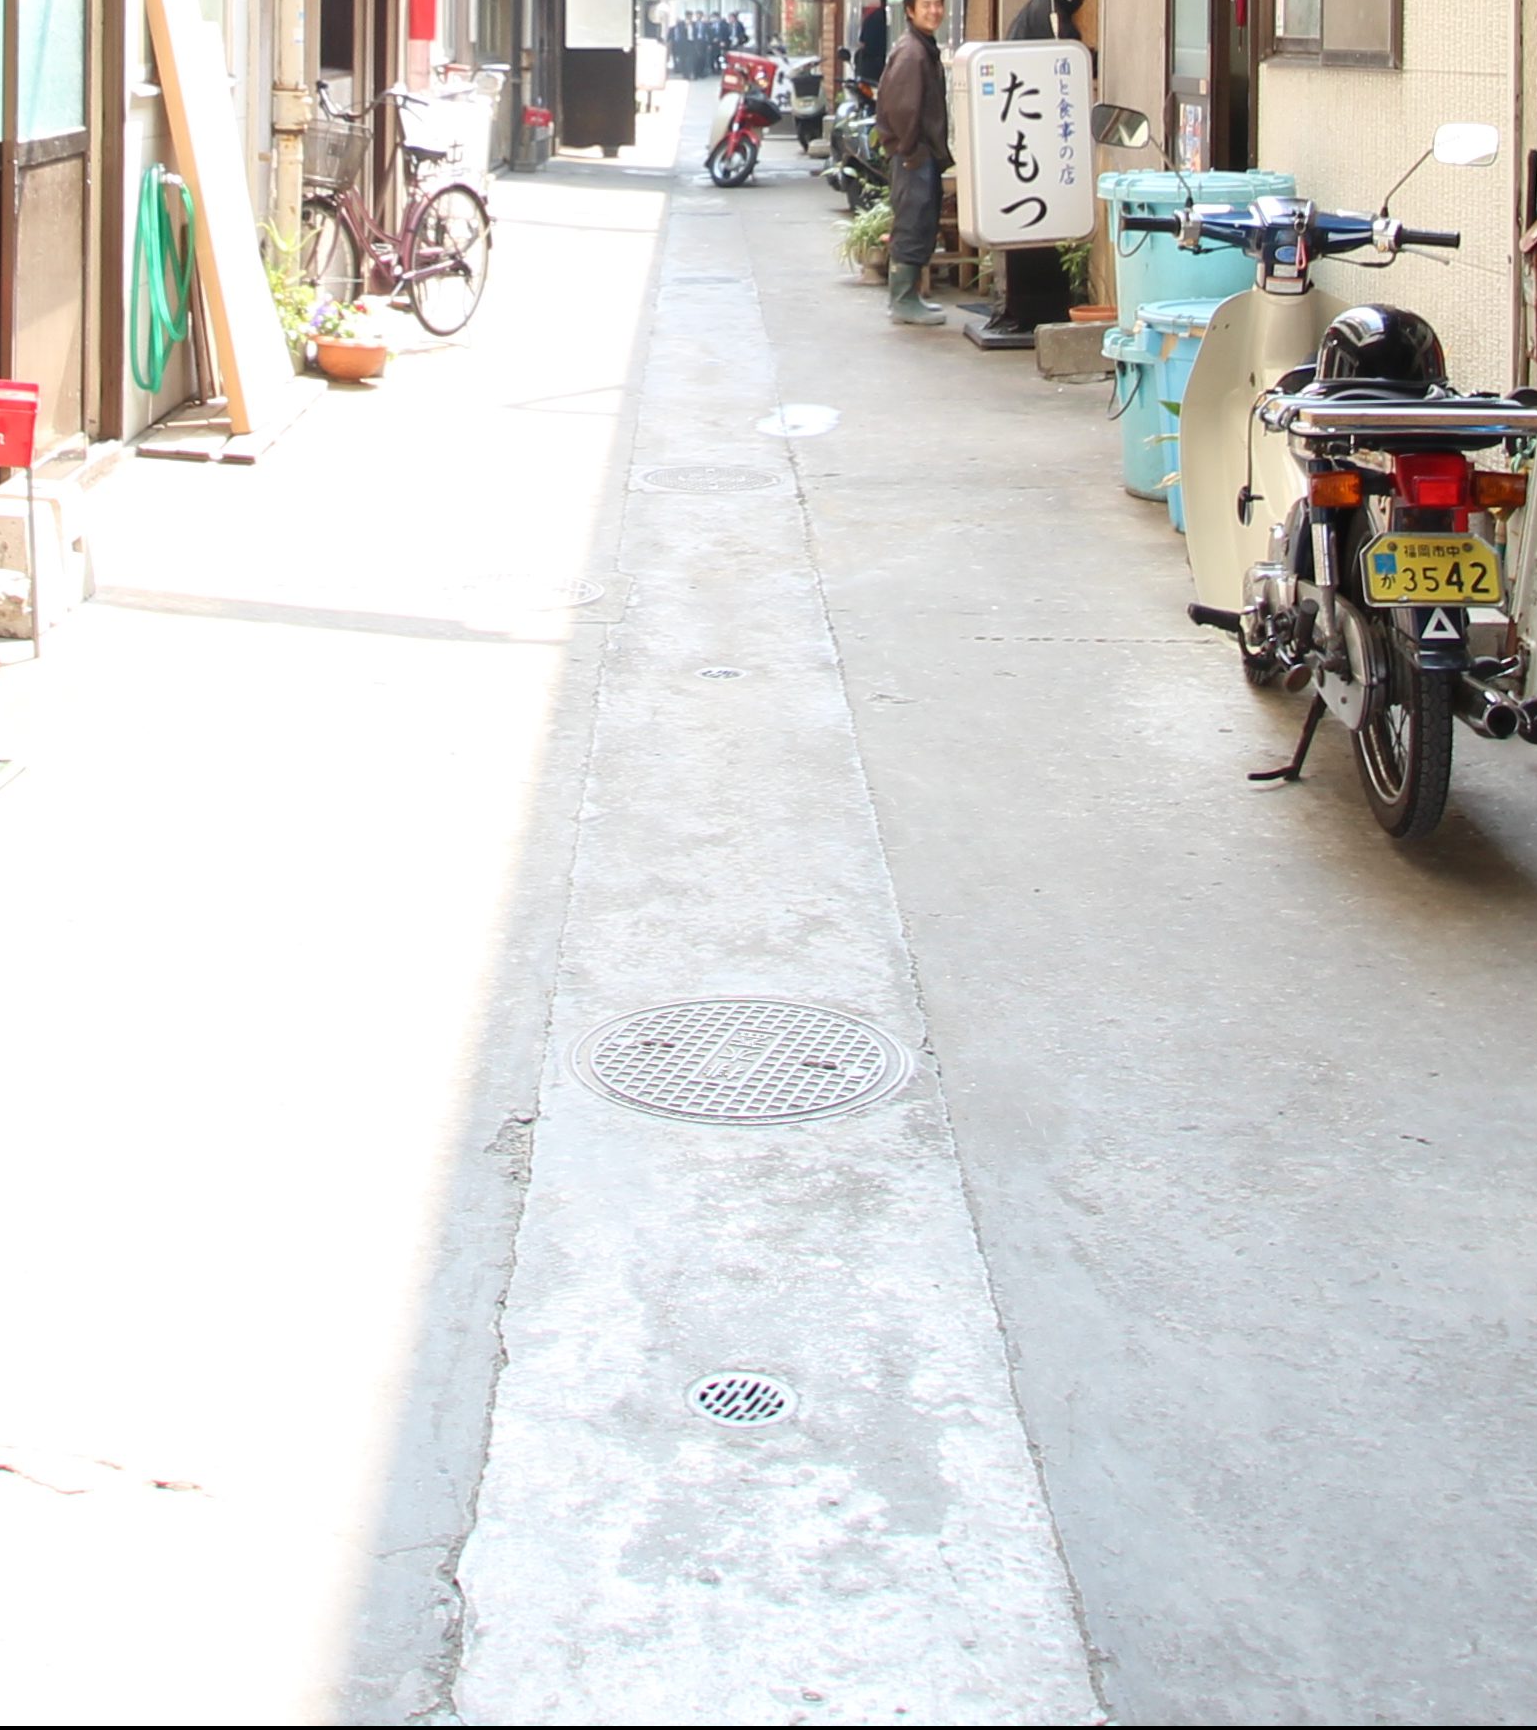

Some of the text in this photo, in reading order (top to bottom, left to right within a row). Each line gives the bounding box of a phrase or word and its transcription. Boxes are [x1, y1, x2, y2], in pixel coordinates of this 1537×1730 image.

[1000, 72, 1047, 229] たもつ
[1054, 58, 1076, 186] 酒と食事の店
[1402, 561, 1490, 594] 3542
[1404, 544, 1460, 559] 福岡市中
